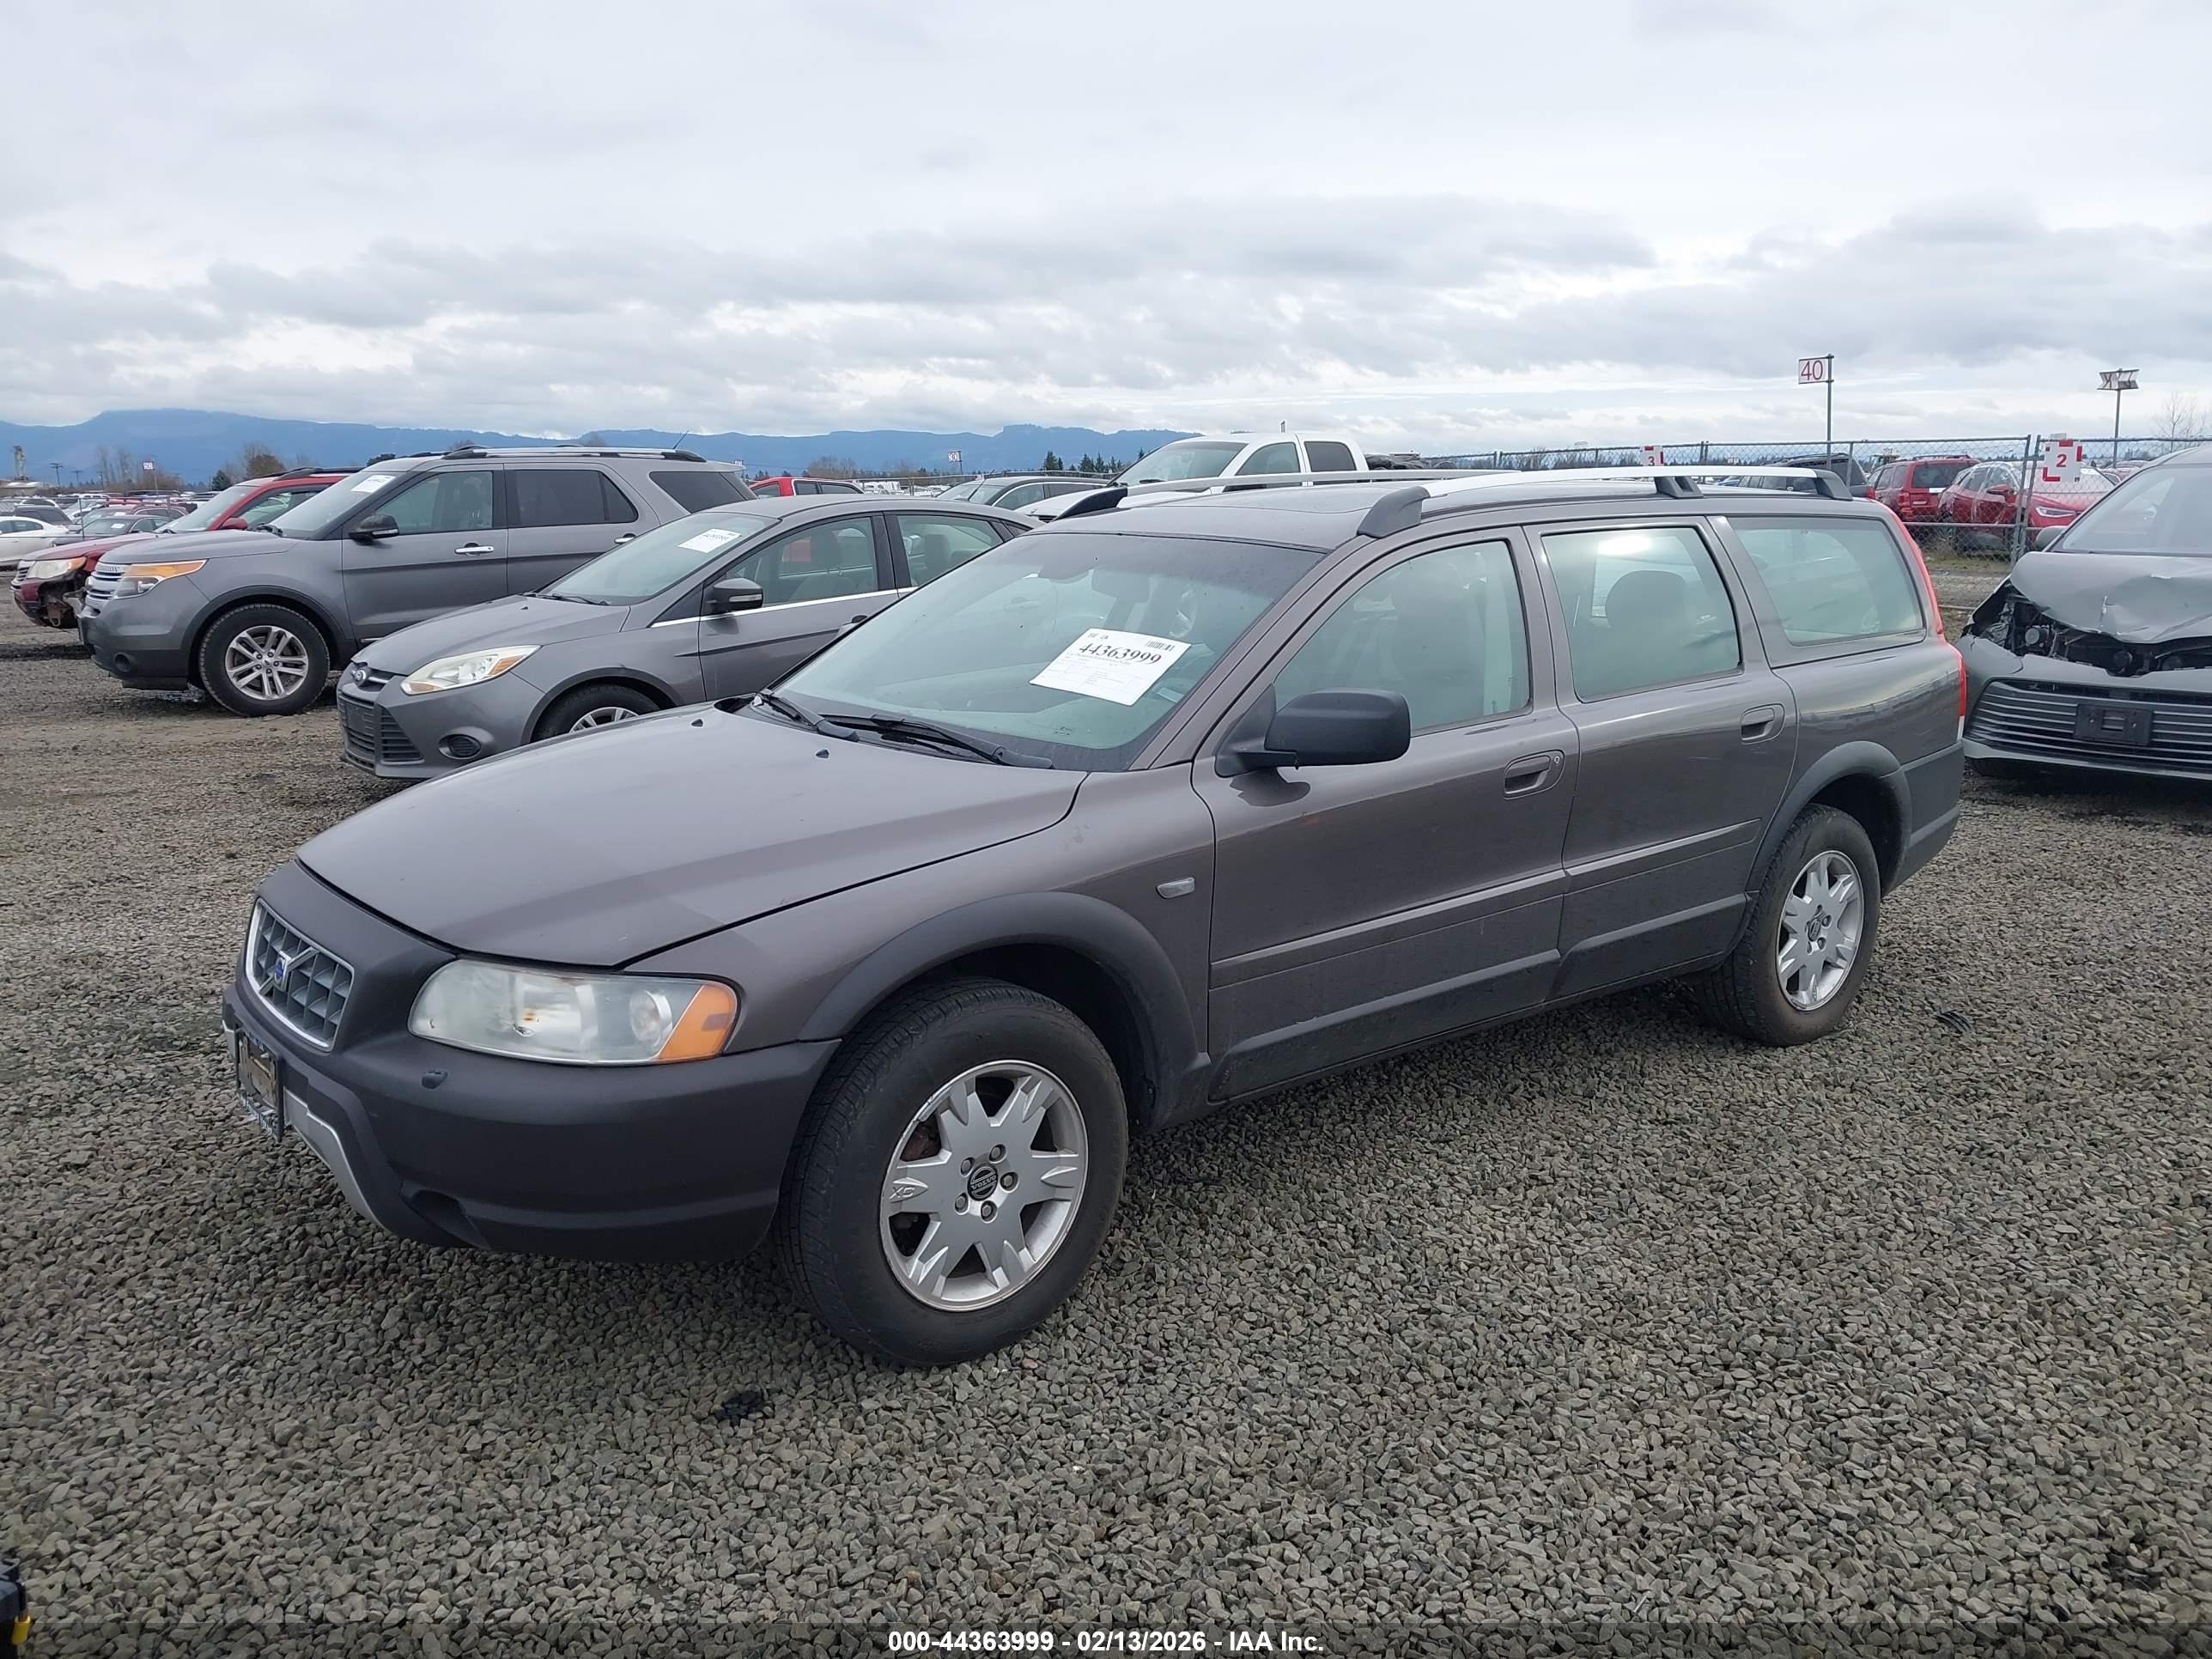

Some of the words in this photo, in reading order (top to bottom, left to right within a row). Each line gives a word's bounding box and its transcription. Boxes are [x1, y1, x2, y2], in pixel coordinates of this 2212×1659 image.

[1801, 360, 1823, 380] 40
[1648, 456, 1655, 466] 3
[2056, 453, 2067, 467] 2
[1079, 642, 1162, 665] 44363999
[970, 1175, 997, 1190] VOLVO
